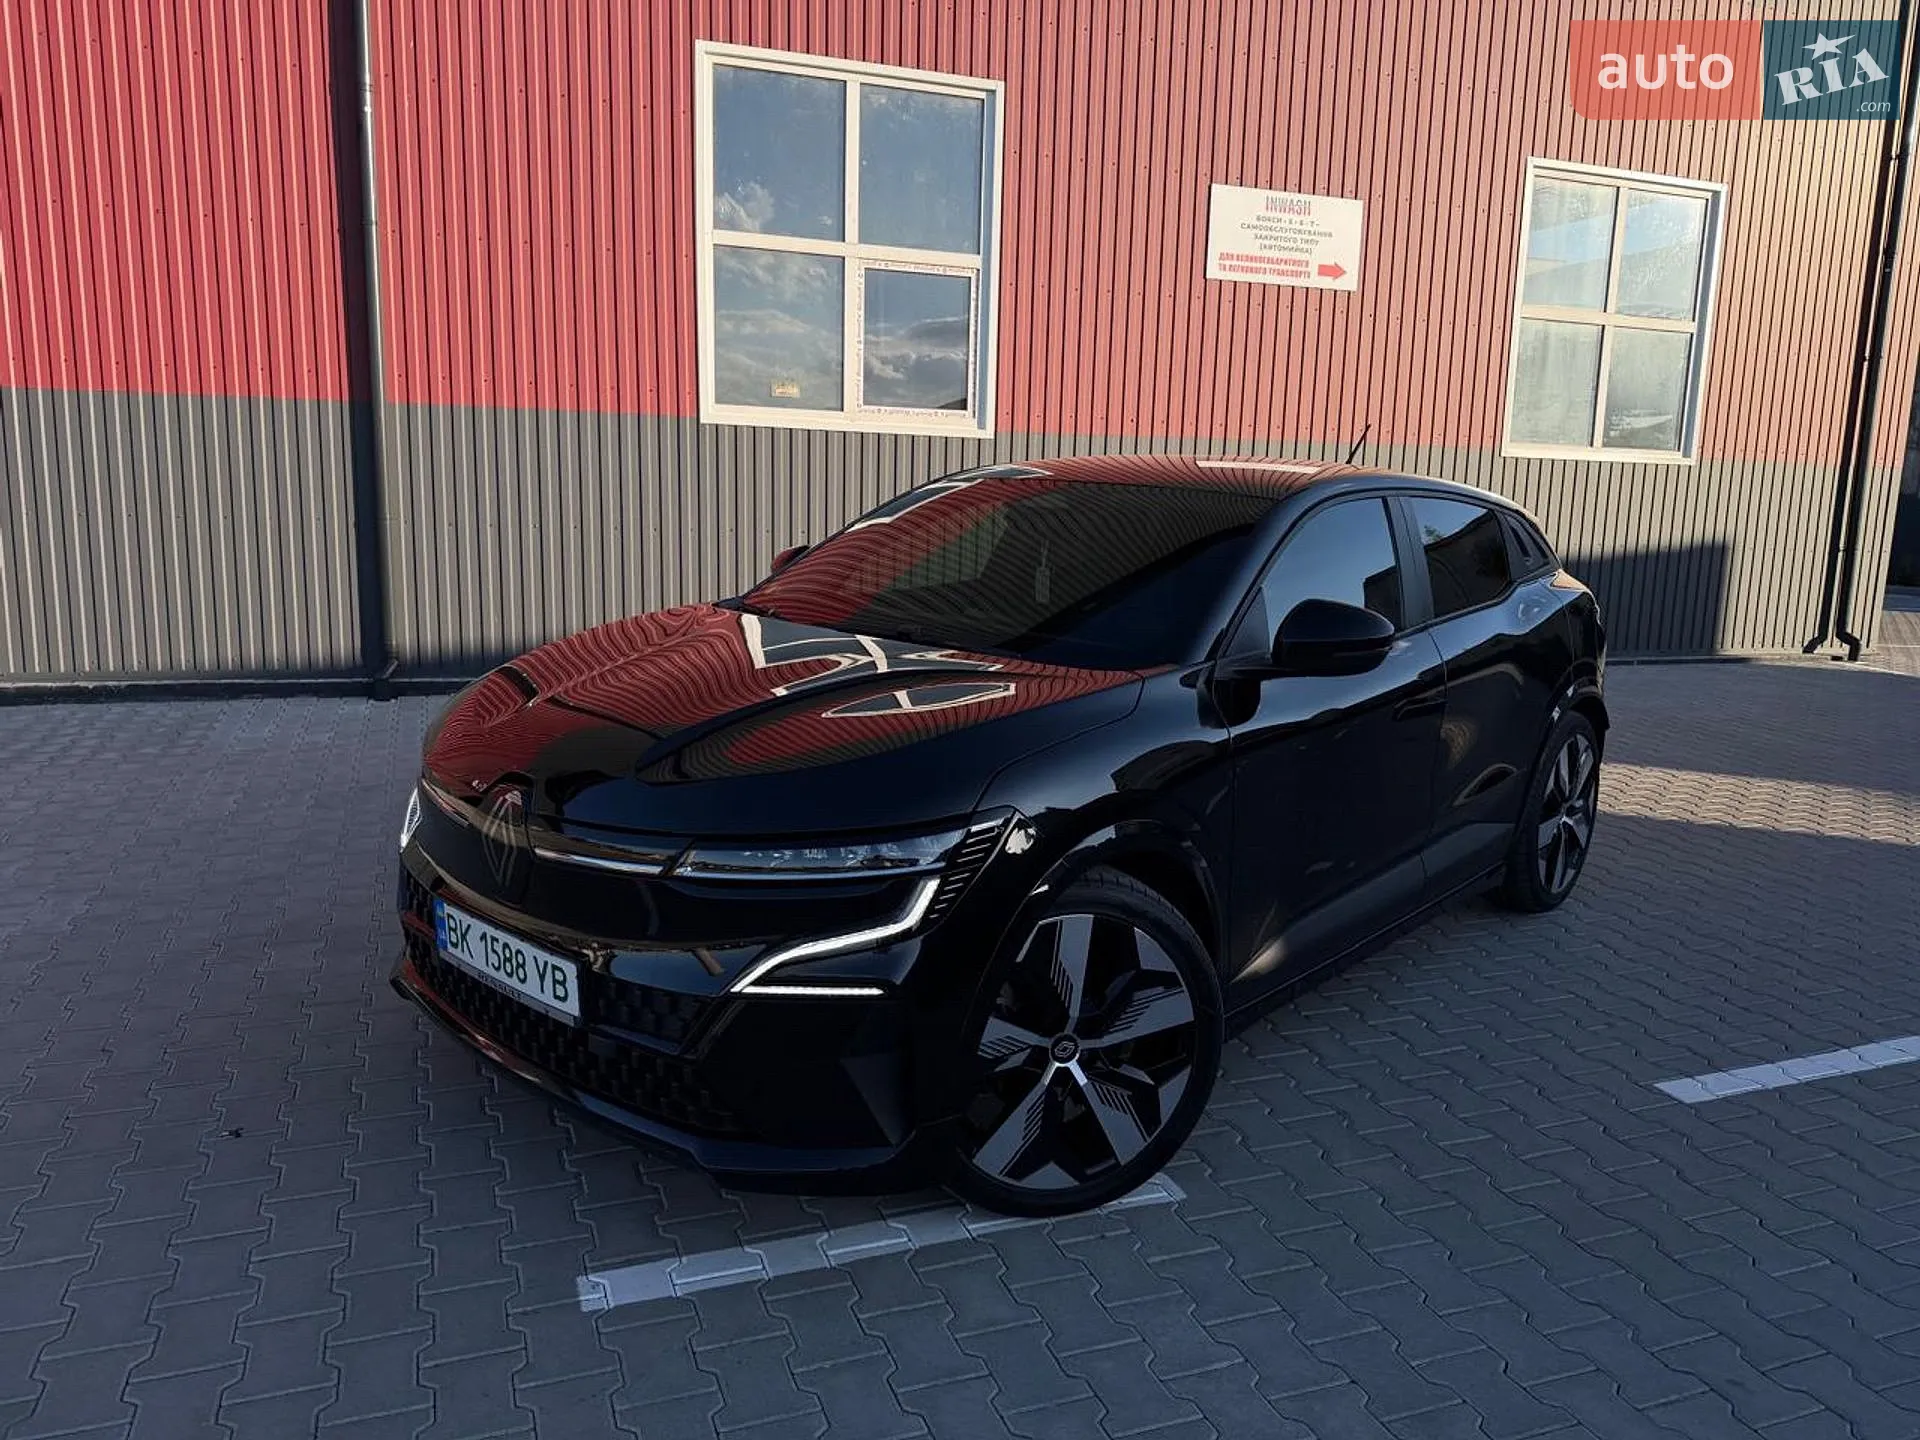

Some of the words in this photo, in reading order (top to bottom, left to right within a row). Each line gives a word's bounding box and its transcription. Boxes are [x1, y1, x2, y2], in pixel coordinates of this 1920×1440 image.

[446, 913, 474, 959] BK
[480, 931, 527, 985] 1588
[533, 955, 569, 1003] YB
